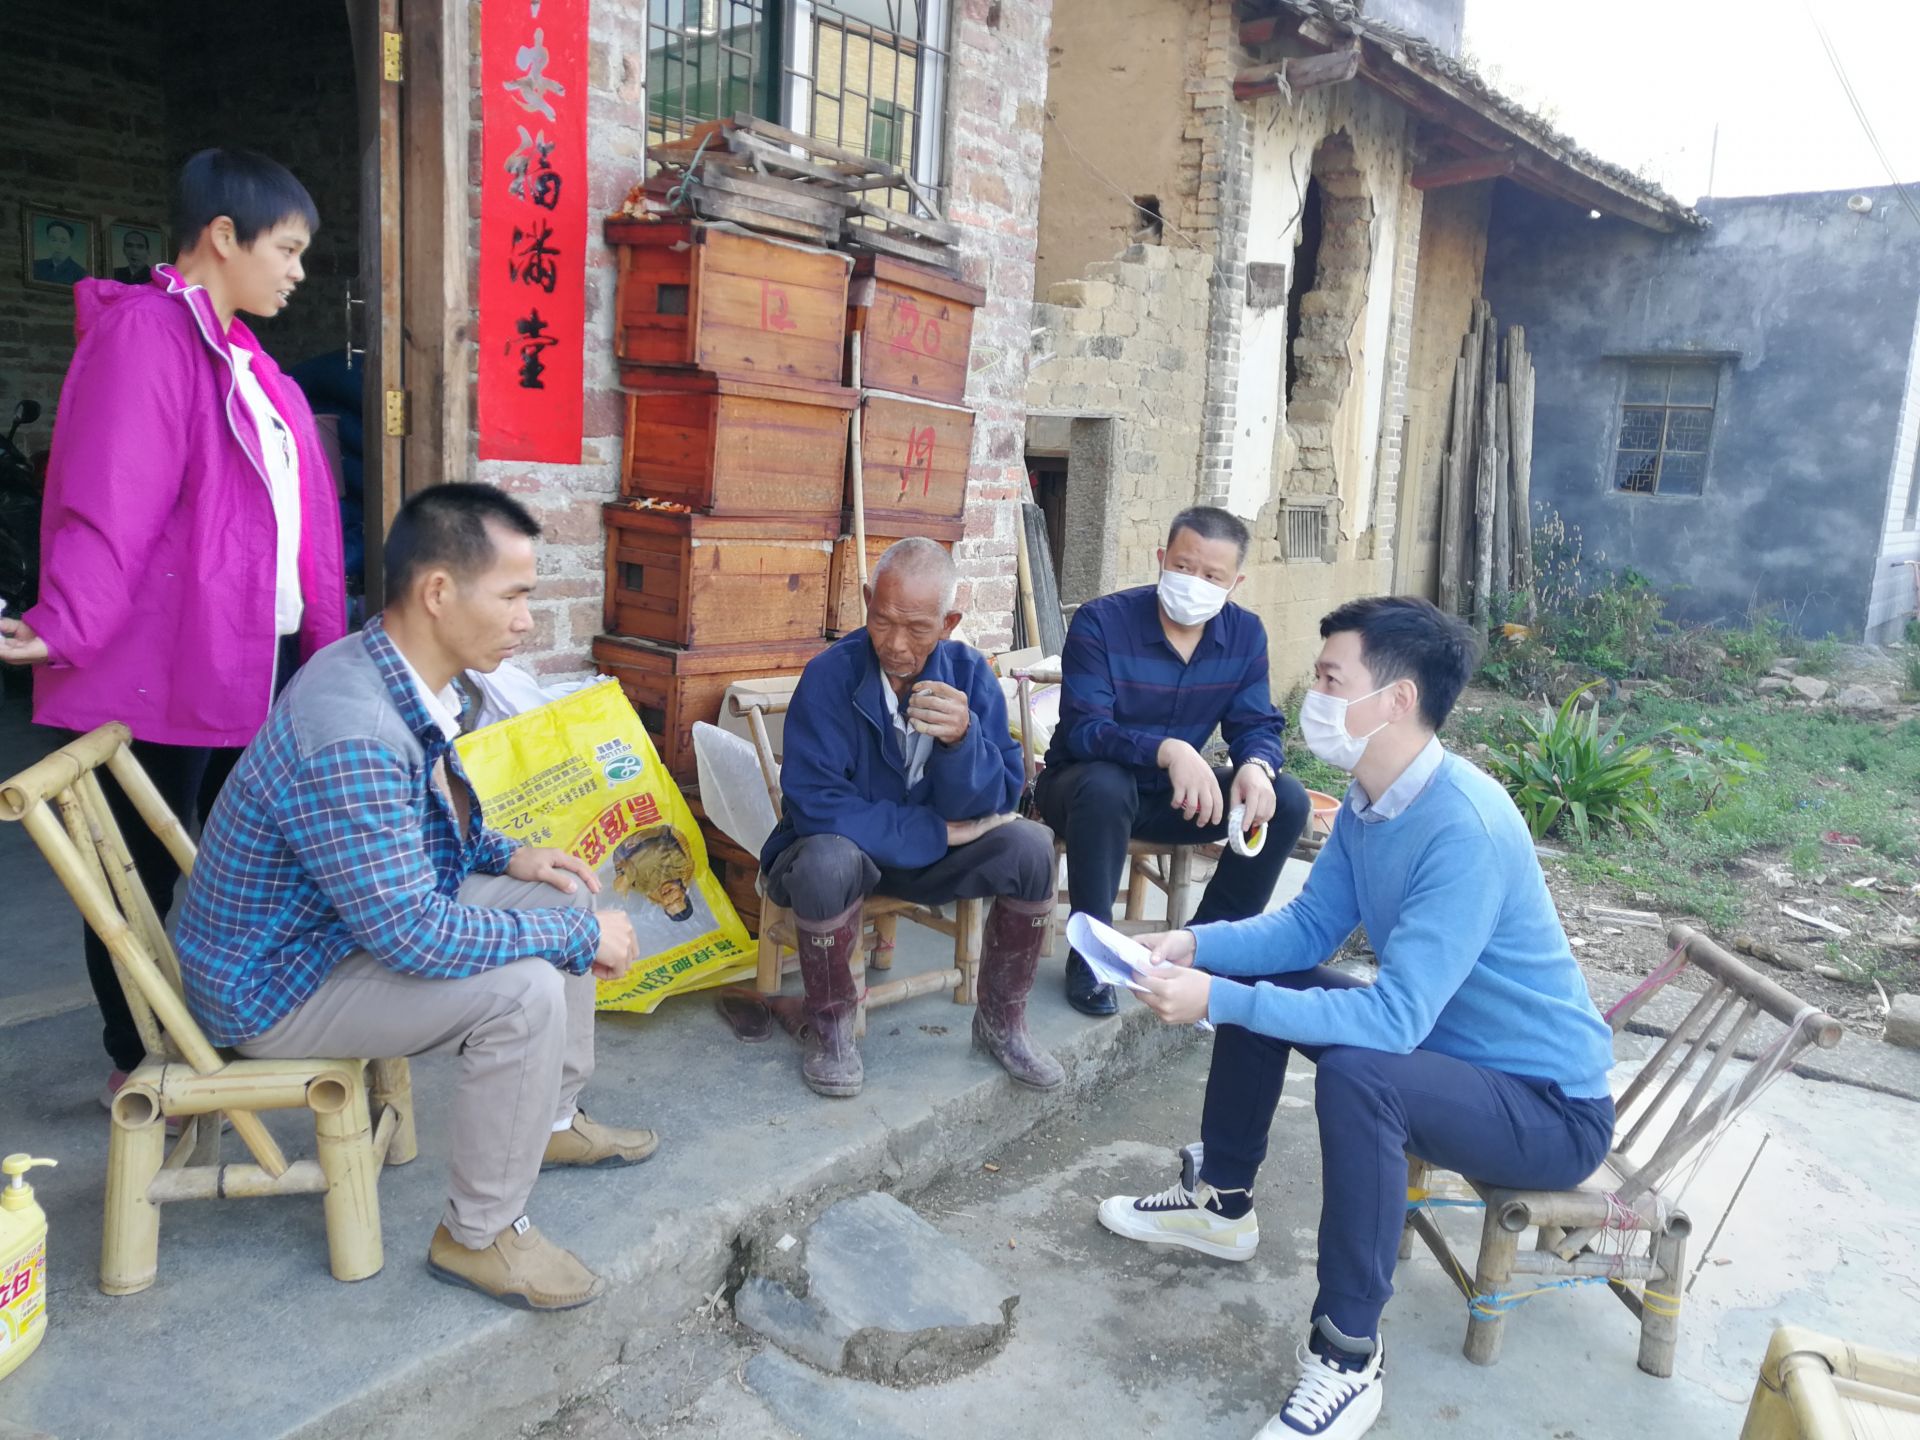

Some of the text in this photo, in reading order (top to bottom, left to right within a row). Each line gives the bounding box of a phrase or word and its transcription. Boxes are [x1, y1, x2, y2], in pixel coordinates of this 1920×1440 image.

[502, 0, 565, 389] 安福满堂
[760, 277, 798, 332] 12
[890, 301, 941, 360] 20
[901, 425, 936, 497] 19
